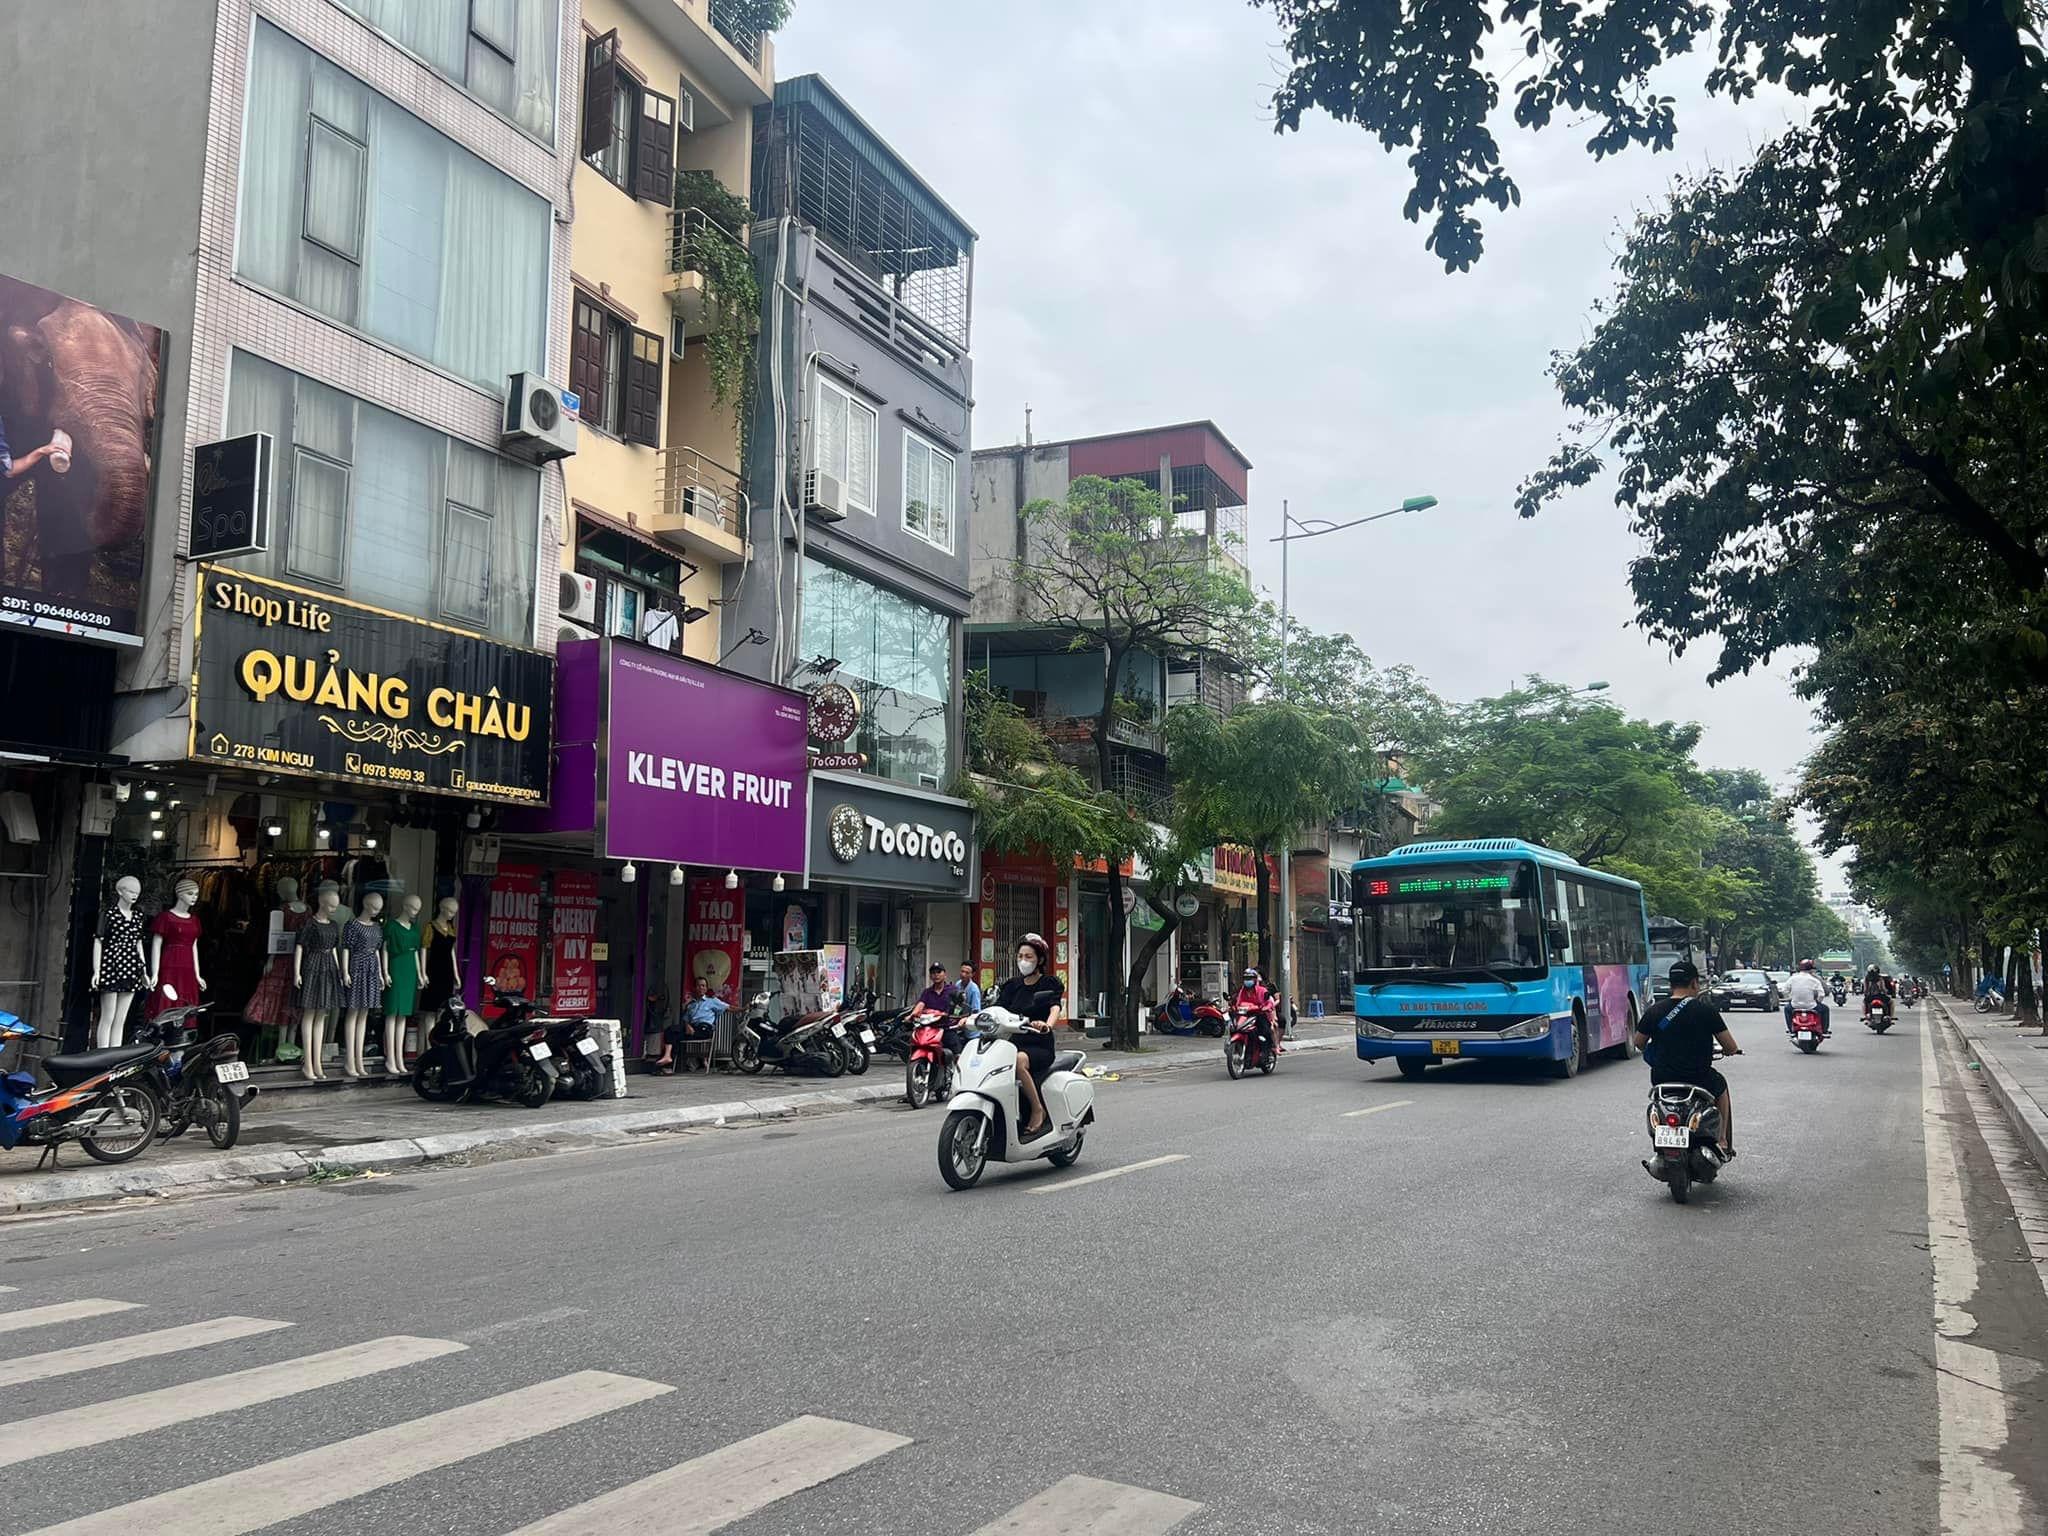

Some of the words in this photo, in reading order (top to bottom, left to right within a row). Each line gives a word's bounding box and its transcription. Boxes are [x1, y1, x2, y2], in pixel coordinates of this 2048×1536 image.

[198, 506, 247, 548] Spa
[2, 596, 30, 611] SĐT:
[34, 602, 111, 626] 0964866280
[216, 582, 282, 626] Shop
[288, 600, 331, 633] Life
[242, 649, 409, 718] QUẢNG
[427, 686, 531, 742] CHÂU
[234, 744, 255, 758] 278
[257, 748, 279, 763] KIM
[363, 763, 387, 778] 0978
[388, 767, 412, 781] 9999
[413, 770, 425, 783] 38
[628, 750, 726, 799] KLEVER
[733, 771, 792, 808] FRUIT
[553, 907, 597, 934] CHERRY
[699, 898, 734, 920] TÁO
[688, 921, 742, 945] NHẬT
